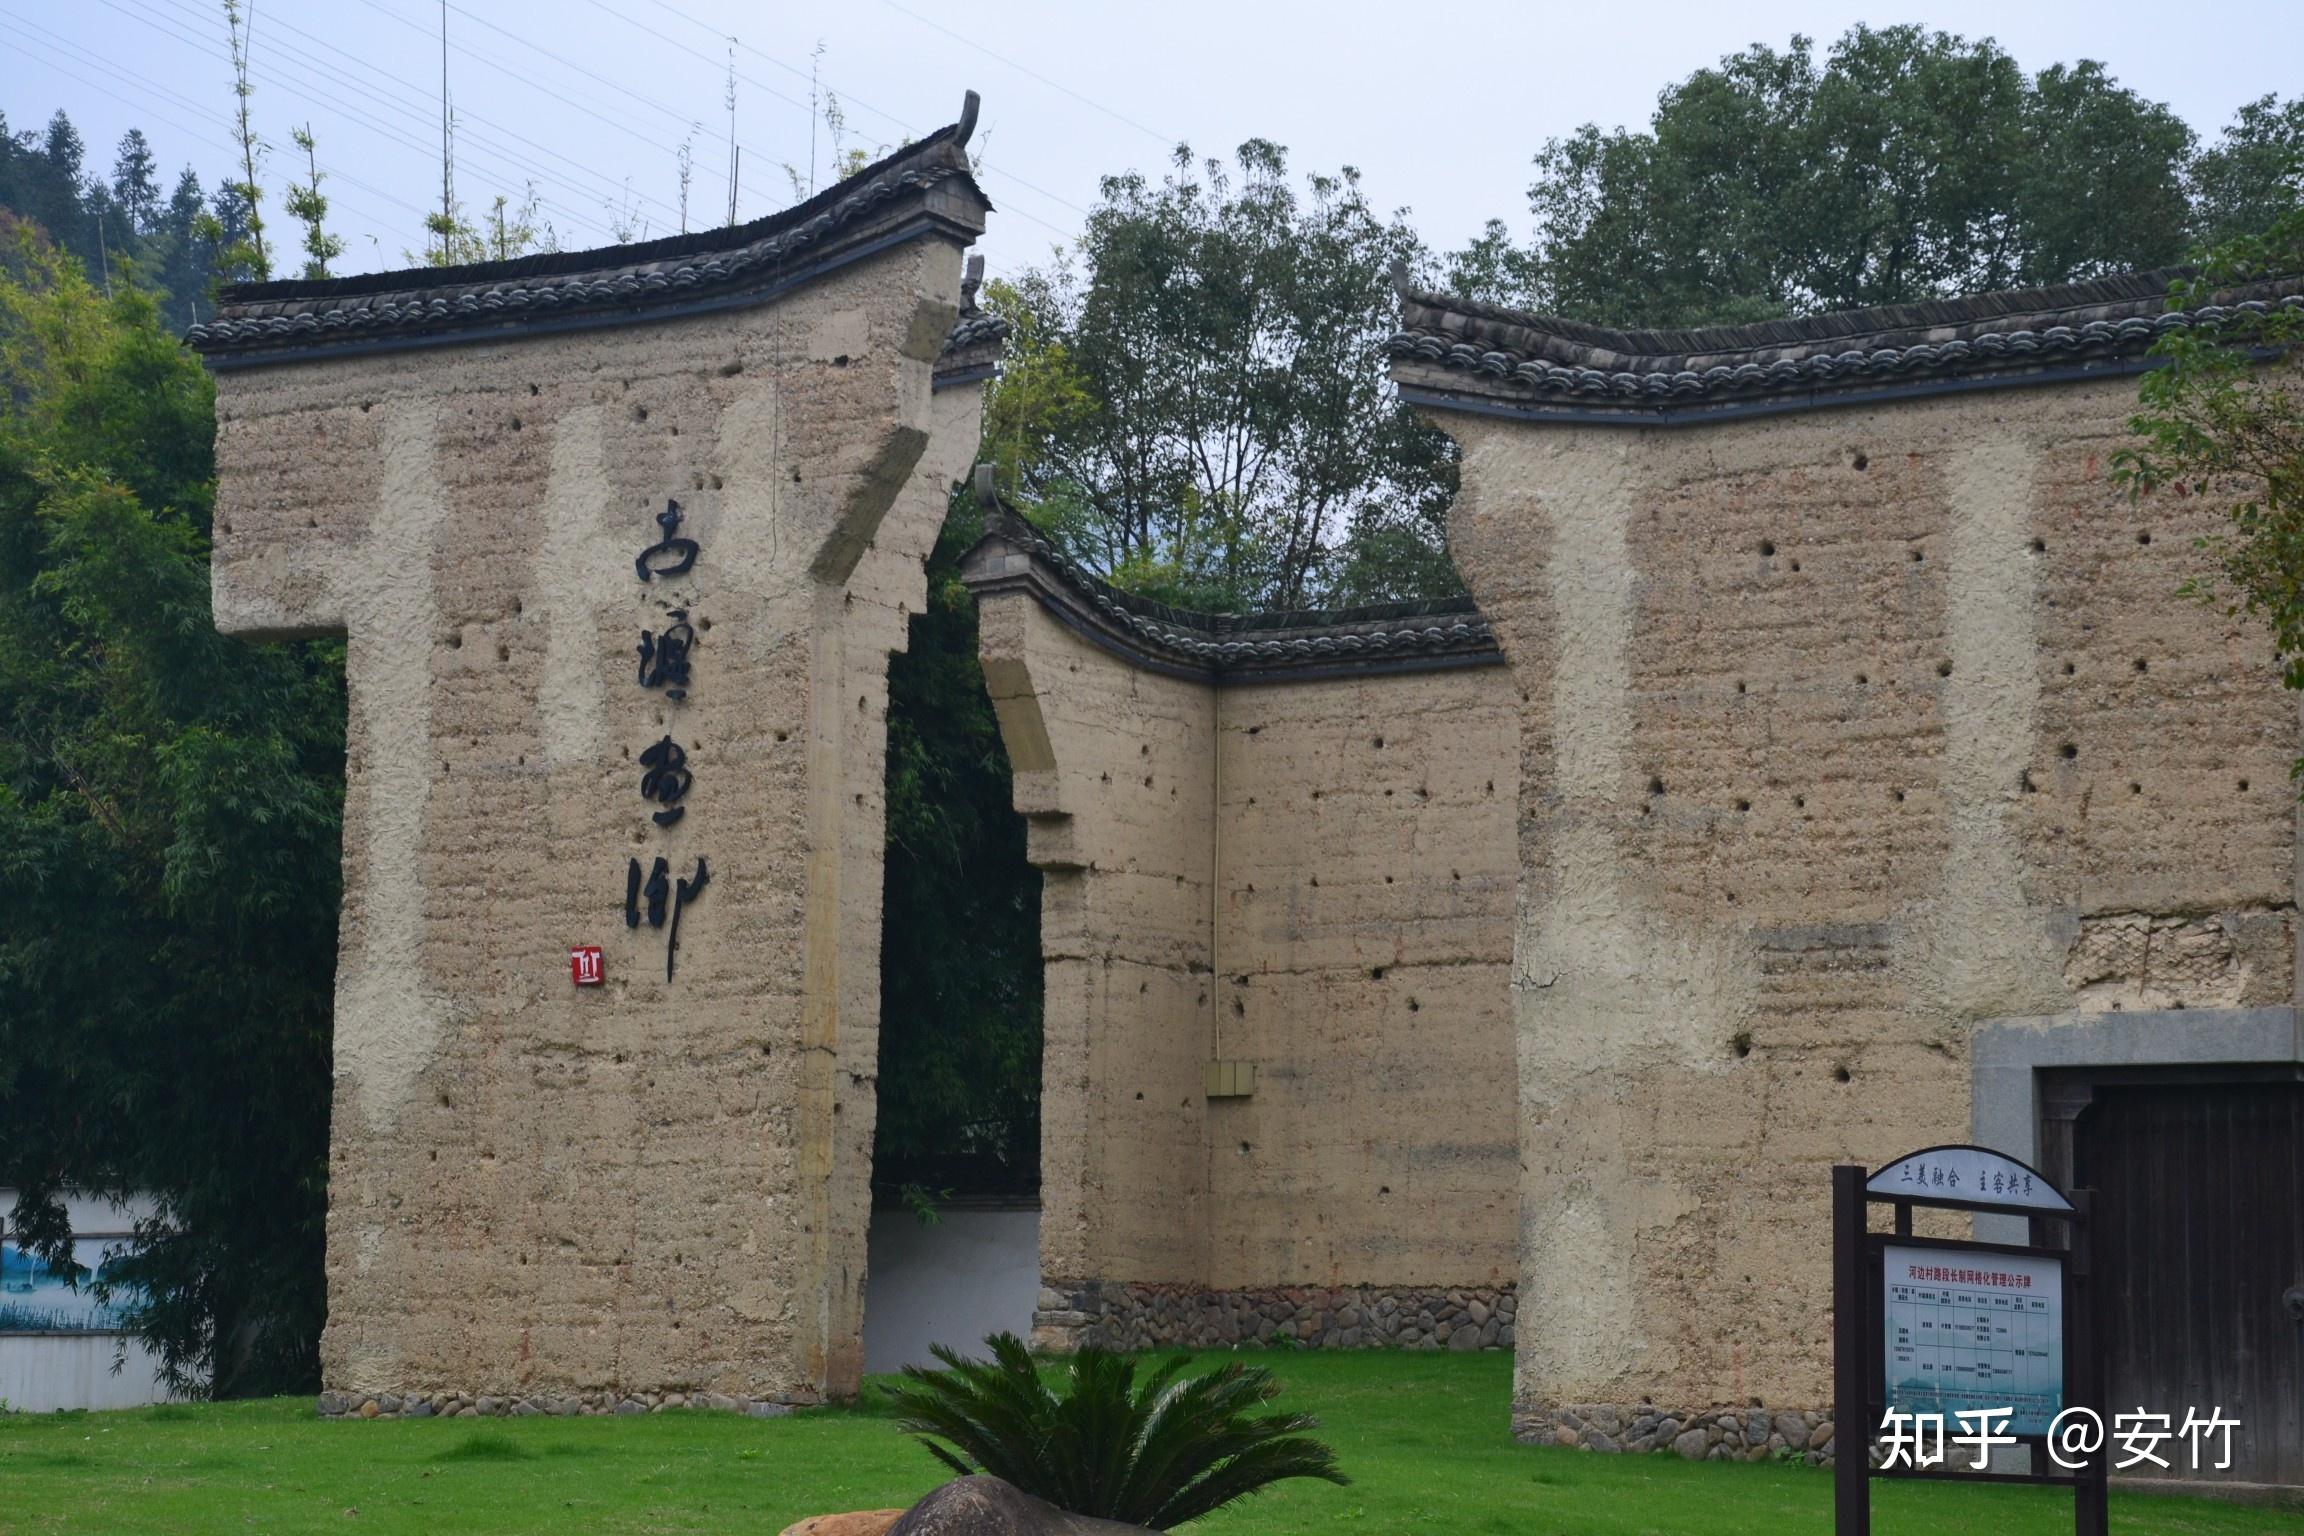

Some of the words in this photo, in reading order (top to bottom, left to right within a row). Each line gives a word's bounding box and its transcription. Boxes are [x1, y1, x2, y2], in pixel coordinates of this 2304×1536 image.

[1900, 1163, 1961, 1188] 三美融合
[1979, 1170, 2033, 1196] 主客共享
